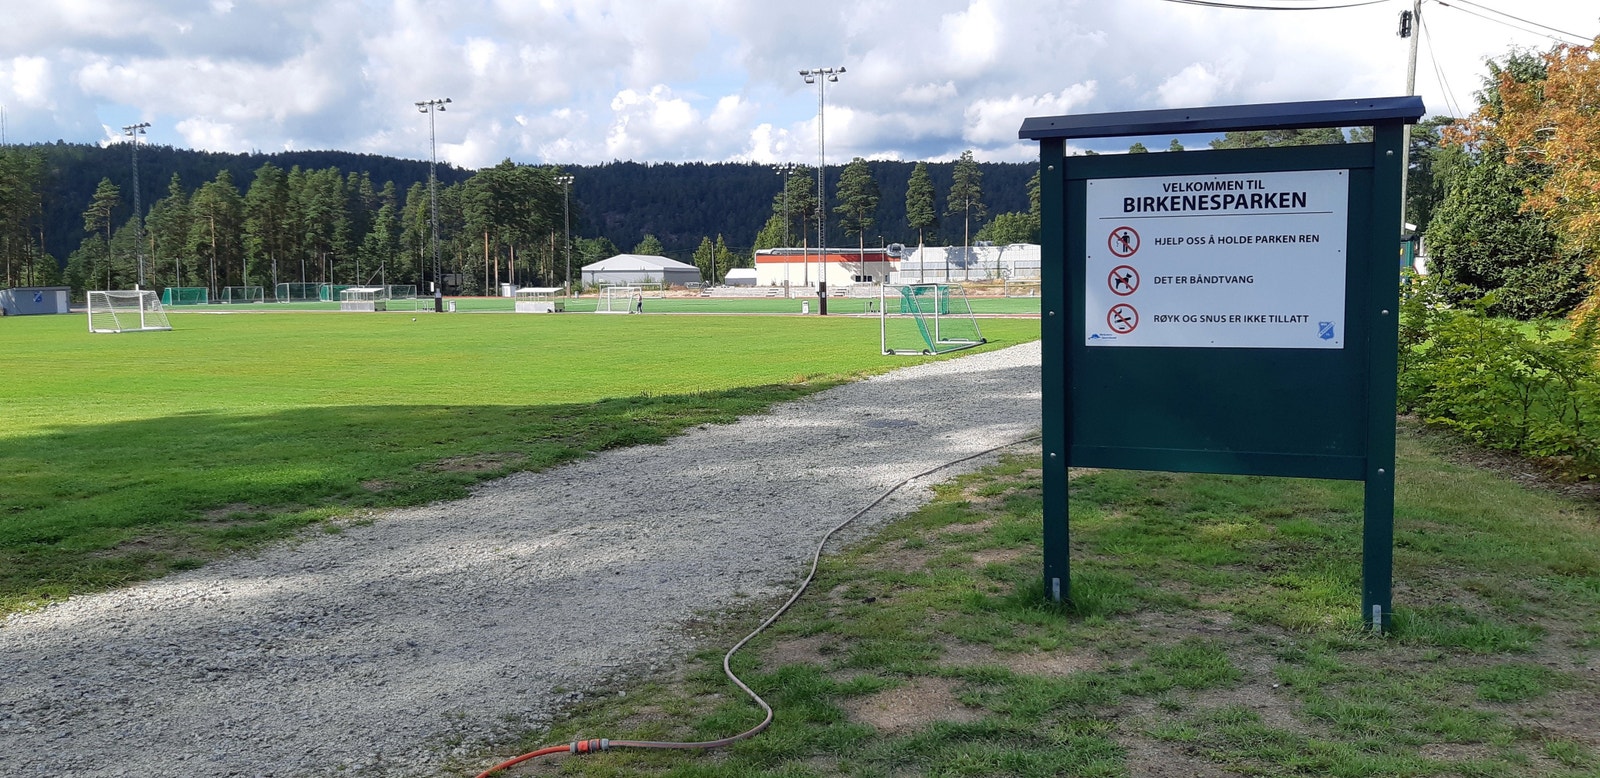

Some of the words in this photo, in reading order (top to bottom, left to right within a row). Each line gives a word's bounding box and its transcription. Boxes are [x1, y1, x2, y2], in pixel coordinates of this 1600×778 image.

[1163, 180, 1243, 193] VELKOMMEN
[1245, 179, 1266, 190] TIL
[1123, 192, 1307, 213] BIRKENESPARKEN
[1154, 237, 1184, 246] HJELP
[1186, 236, 1205, 245] OSS
[1208, 233, 1215, 245] Å
[1217, 236, 1253, 245] HOLDE
[1255, 235, 1296, 244] PARKEN
[1298, 235, 1320, 243] REN
[1154, 276, 1173, 285] DET
[1176, 276, 1187, 285] ER
[1189, 273, 1254, 284] BÅNDTVANG
[1153, 314, 1180, 323] RØYK
[1182, 314, 1198, 323] OG
[1199, 314, 1227, 323] SNUS
[1229, 314, 1241, 323] ER
[1243, 314, 1267, 323] IKKE
[1269, 314, 1309, 323] TILLATT
